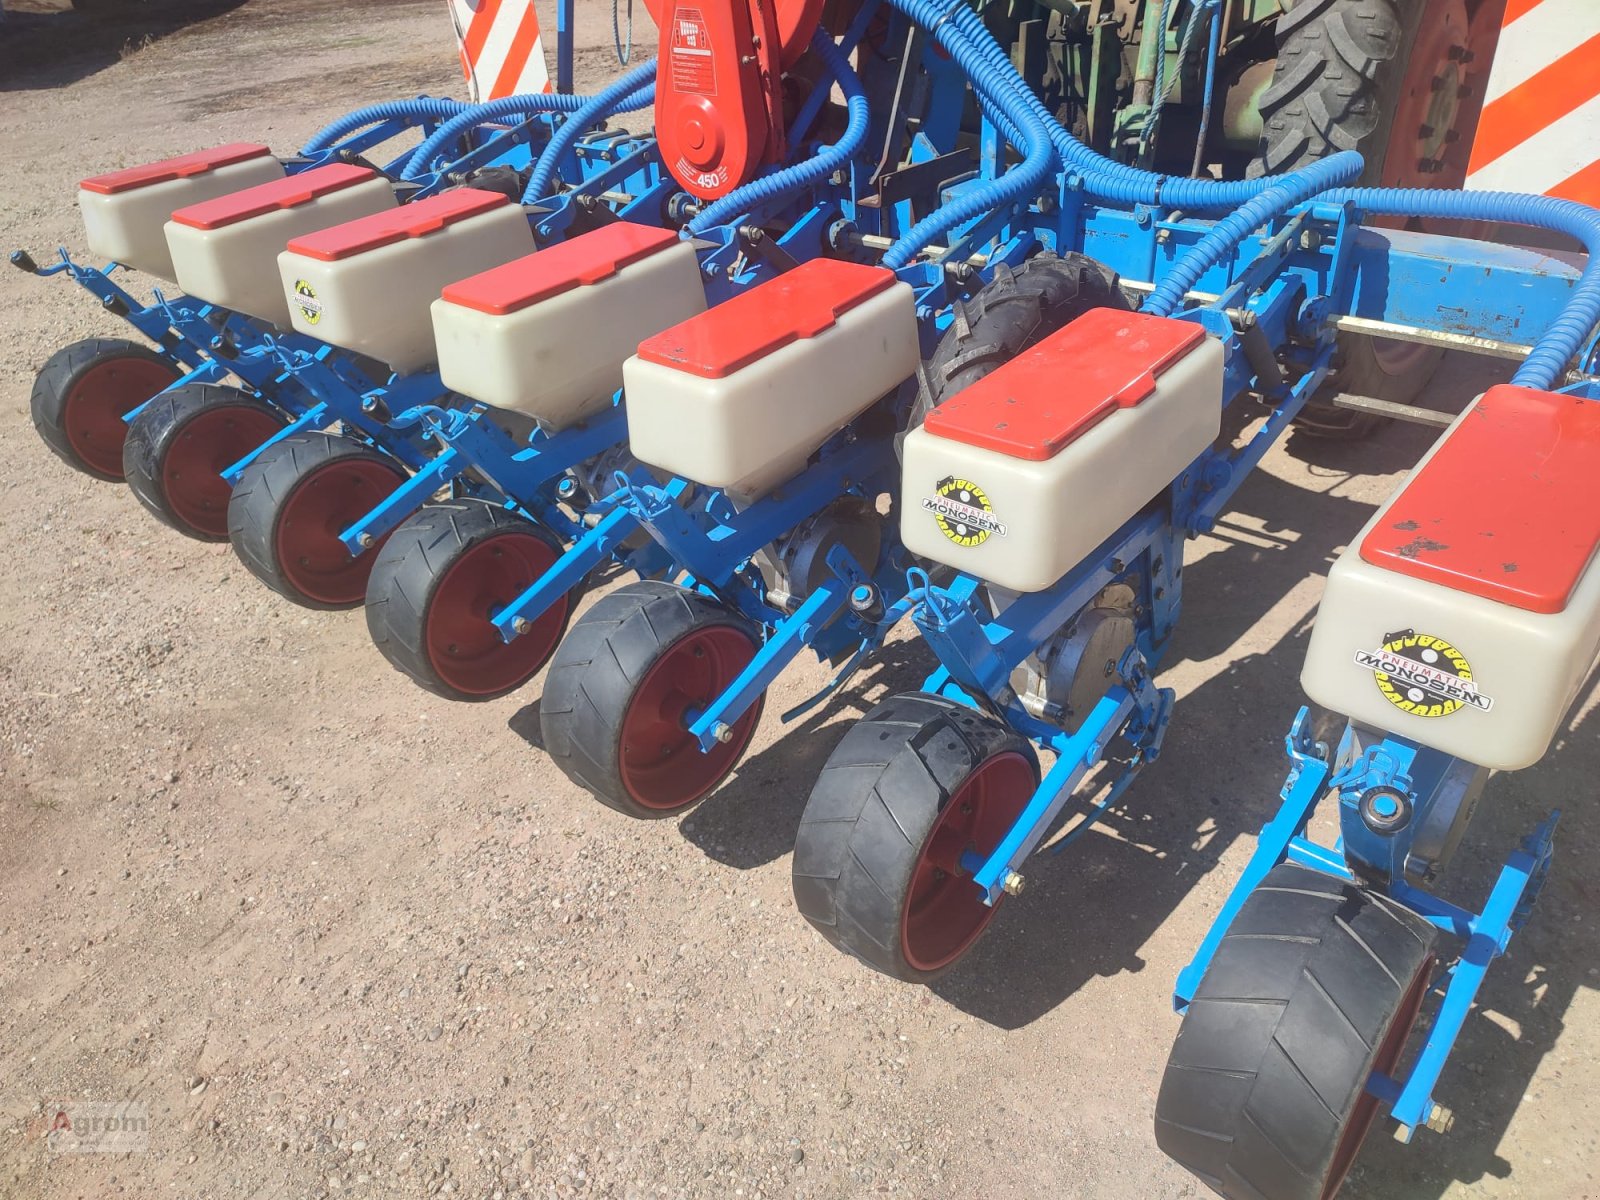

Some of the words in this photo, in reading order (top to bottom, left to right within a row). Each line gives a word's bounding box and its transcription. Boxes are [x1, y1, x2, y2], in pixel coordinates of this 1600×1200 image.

[697, 173, 720, 188] 450
[926, 500, 1002, 534] MONOSEM
[937, 497, 991, 520] PNEUMATIC
[1360, 654, 1484, 707] MONOSEM
[1382, 653, 1469, 690] PNEUMATIC
